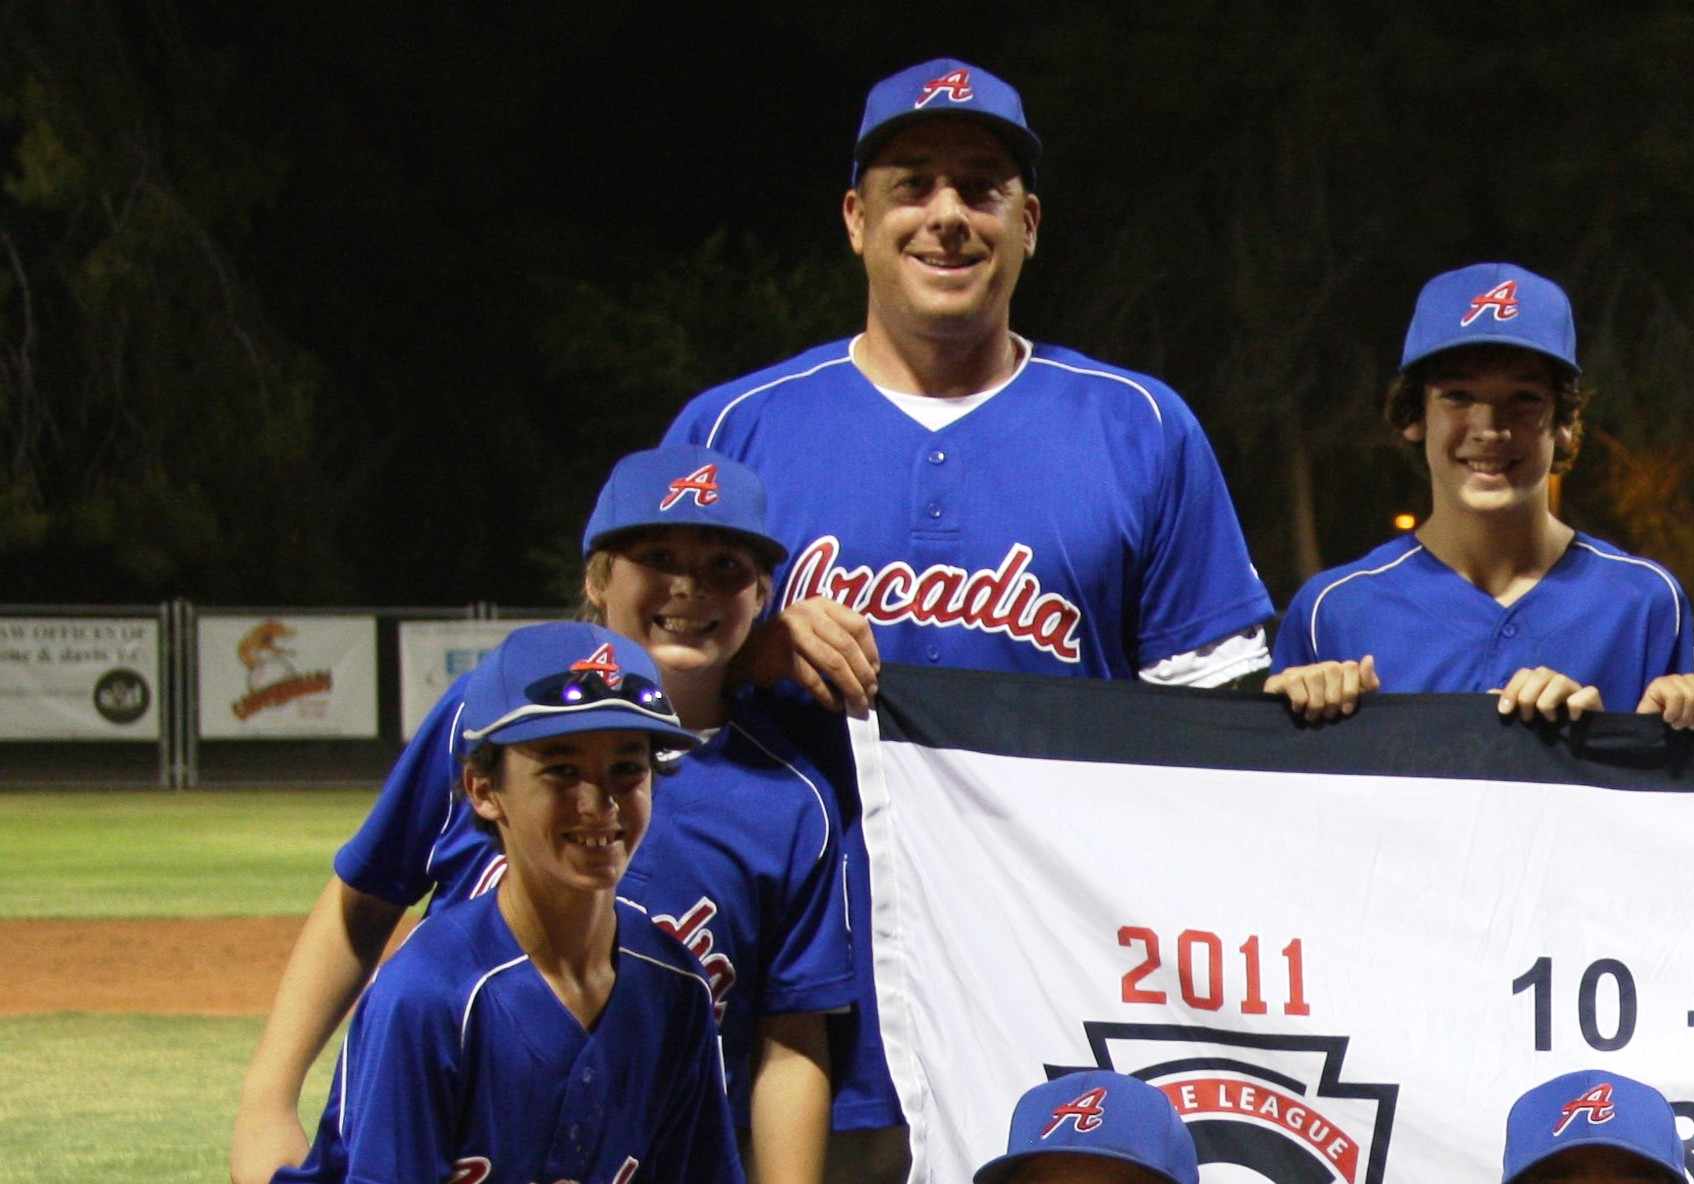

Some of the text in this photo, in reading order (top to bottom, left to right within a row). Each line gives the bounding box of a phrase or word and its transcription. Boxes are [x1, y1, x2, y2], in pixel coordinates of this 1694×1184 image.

[914, 68, 974, 109] A
[1460, 279, 1520, 327] A
[659, 464, 720, 511] A
[781, 535, 1081, 663] Arcadia
[569, 642, 624, 690] A
[1117, 925, 1311, 1017] 2011
[1511, 956, 1638, 1053] 10
[1040, 1086, 1105, 1141] A
[1218, 1083, 1350, 1161] LEAGUE
[1552, 1081, 1616, 1137] A
